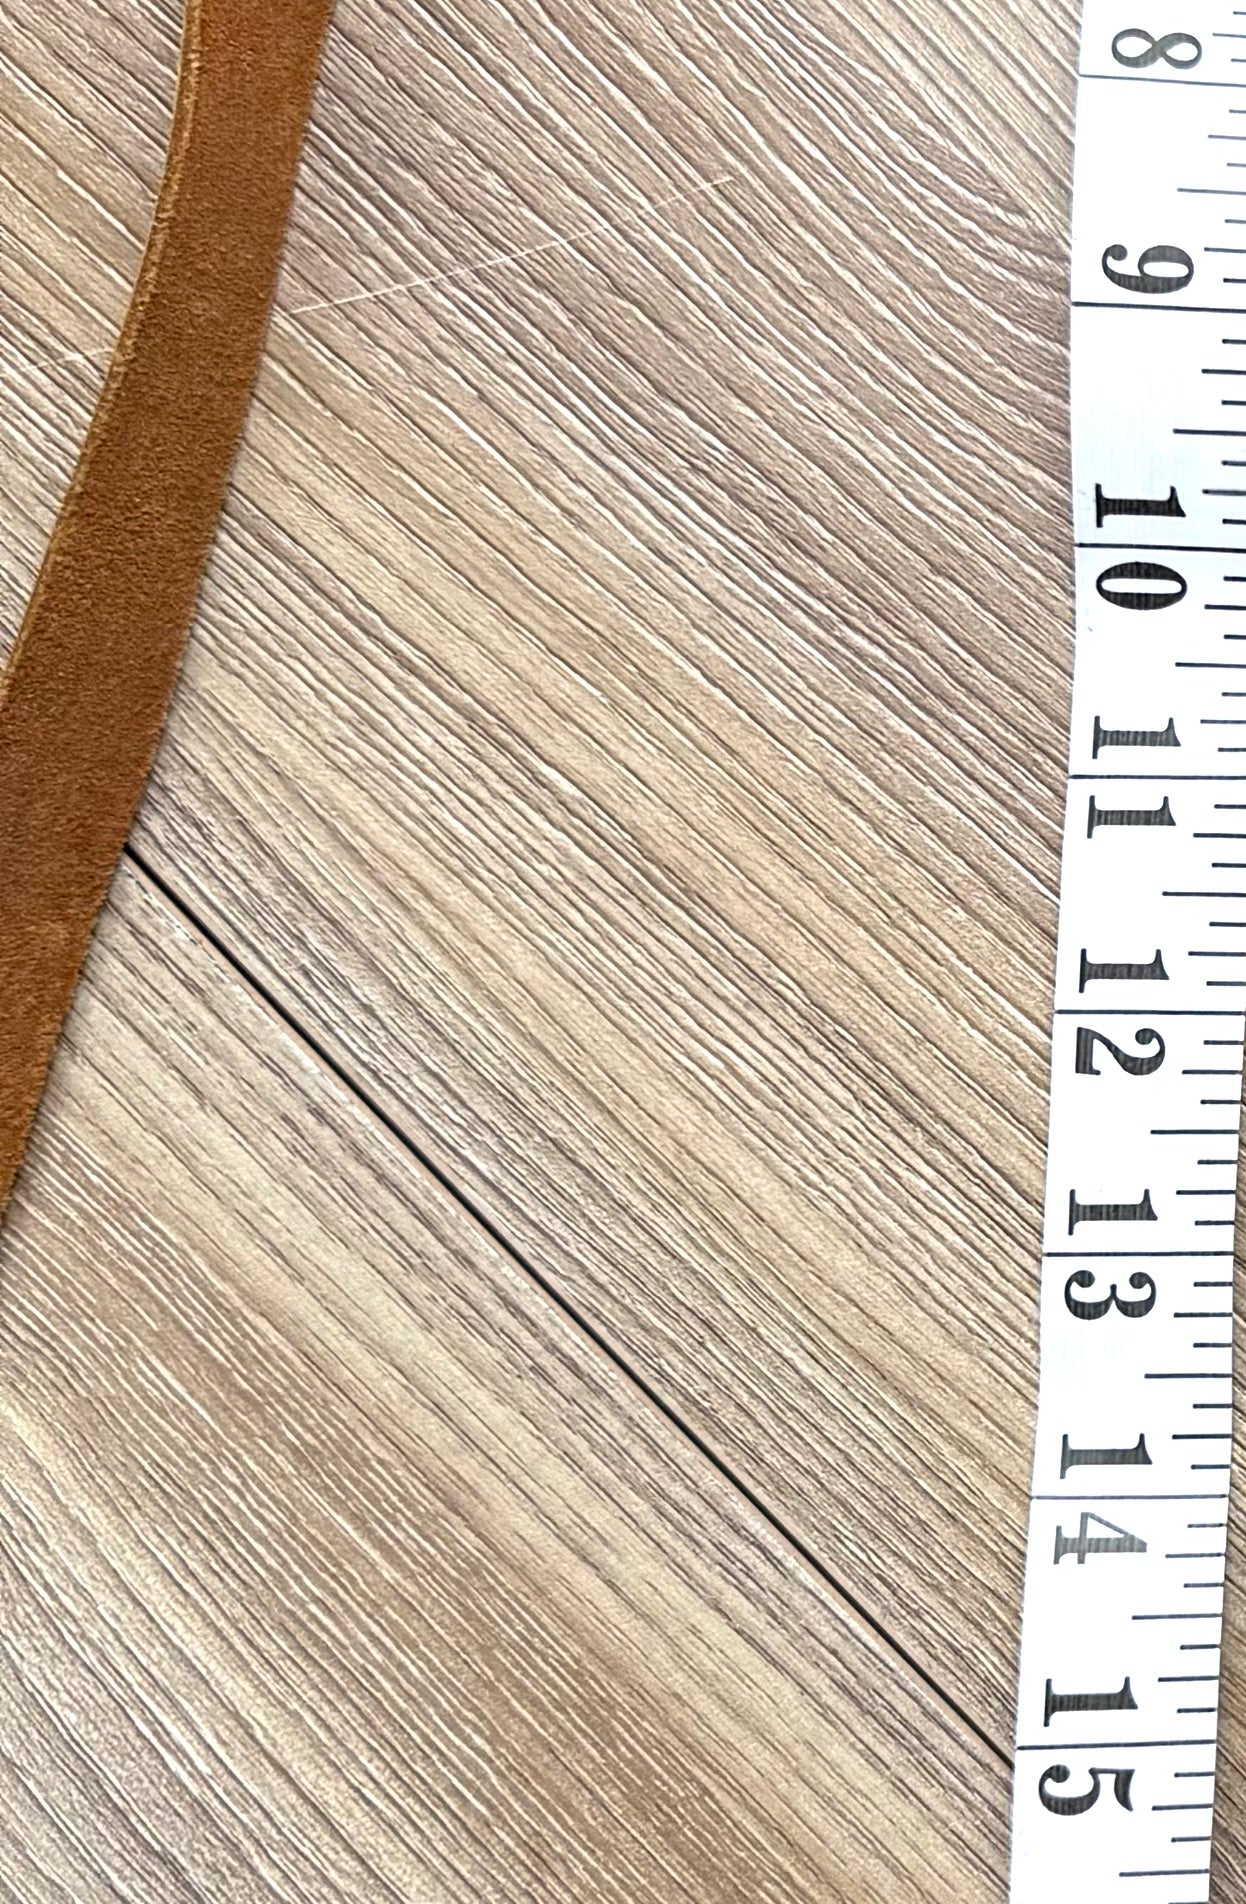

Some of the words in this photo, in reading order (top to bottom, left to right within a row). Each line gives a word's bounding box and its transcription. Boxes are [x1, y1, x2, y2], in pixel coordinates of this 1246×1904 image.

[1112, 29, 1202, 69] 8
[1102, 245, 1194, 294] 9
[1095, 483, 1187, 610] 10
[1087, 716, 1181, 839] 11
[1075, 948, 1169, 1075] 12
[1064, 1189, 1158, 1320] 13
[1054, 1433, 1152, 1564] 14
[1039, 1677, 1138, 1816] 15
